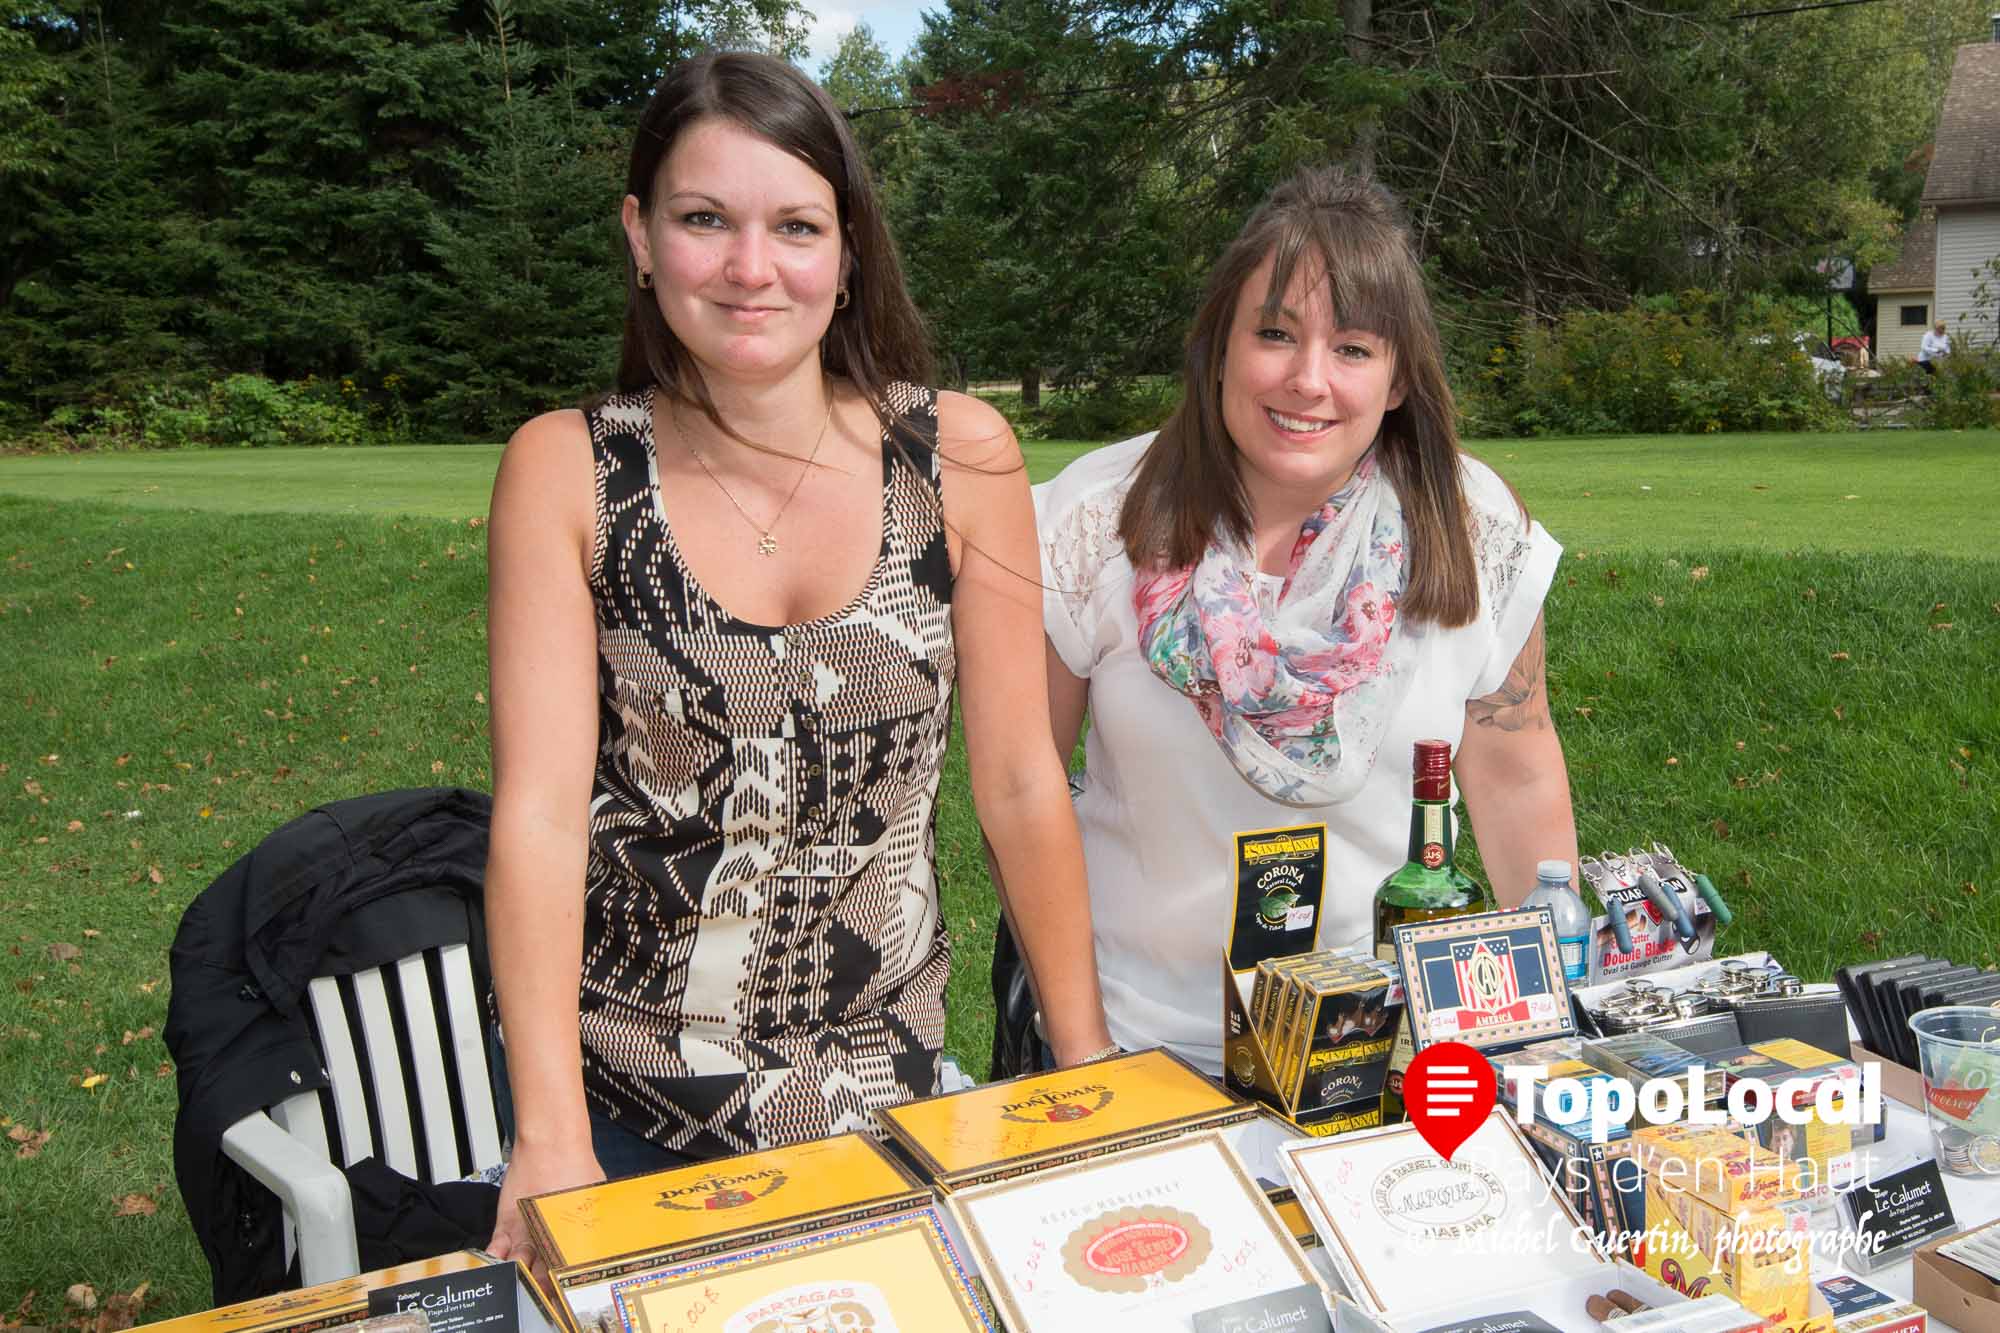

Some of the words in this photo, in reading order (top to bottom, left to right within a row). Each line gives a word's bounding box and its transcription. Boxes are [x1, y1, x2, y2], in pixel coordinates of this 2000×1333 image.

[1257, 865, 1305, 889] CORONA
[1603, 965, 1619, 976] Oval
[1620, 963, 1629, 972] 54
[1652, 954, 1673, 964] Cutter
[1475, 1012, 1514, 1027] AMERICA
[1321, 1075, 1363, 1097] CORONA
[1002, 1095, 1045, 1113] DON
[658, 1181, 710, 1200] DON
[1874, 1199, 1890, 1214] Le
[1889, 1180, 1933, 1207] Calumet
[421, 1282, 494, 1309] Calumet
[744, 1286, 856, 1324] PARTAGAS
[1245, 1304, 1309, 1333] Calumet
